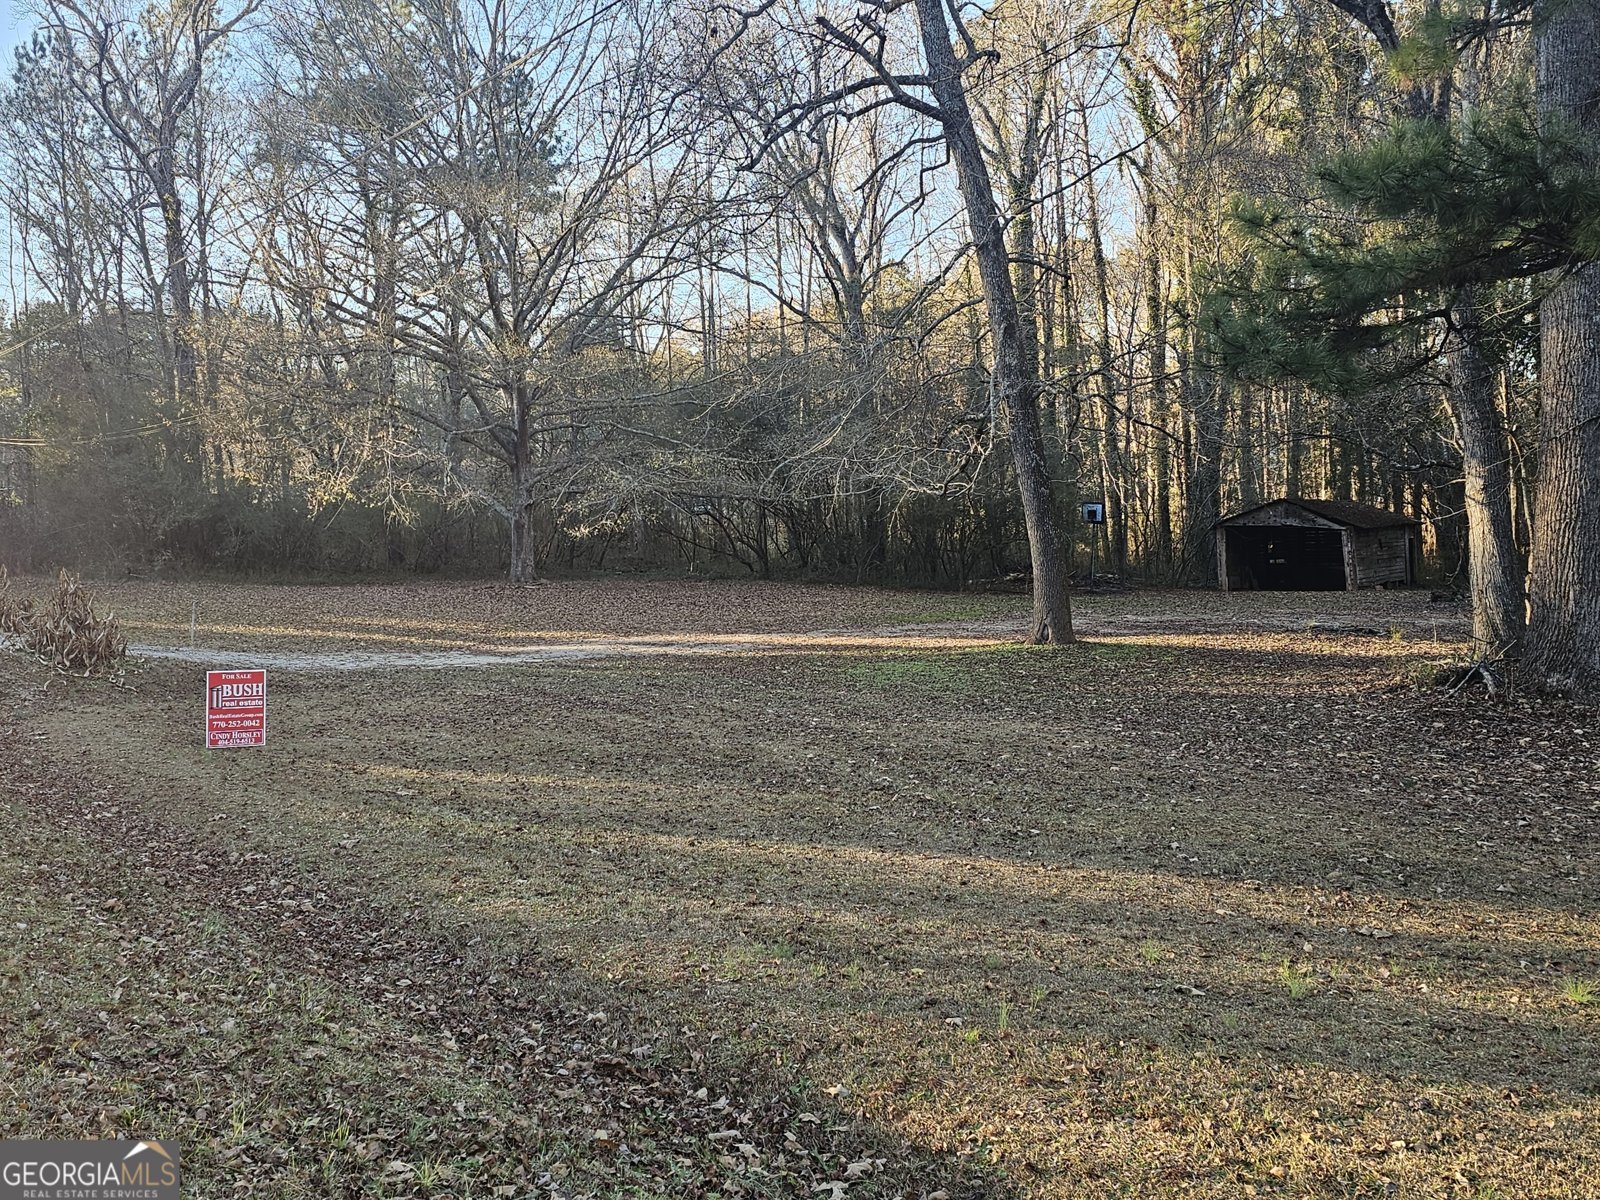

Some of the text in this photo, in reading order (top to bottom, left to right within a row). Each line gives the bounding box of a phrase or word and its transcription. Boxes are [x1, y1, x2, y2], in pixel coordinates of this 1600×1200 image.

[222, 683, 263, 697] BUSH
[213, 719, 260, 728] 770-252-0042
[210, 731, 262, 740] CINDY HORSLEY
